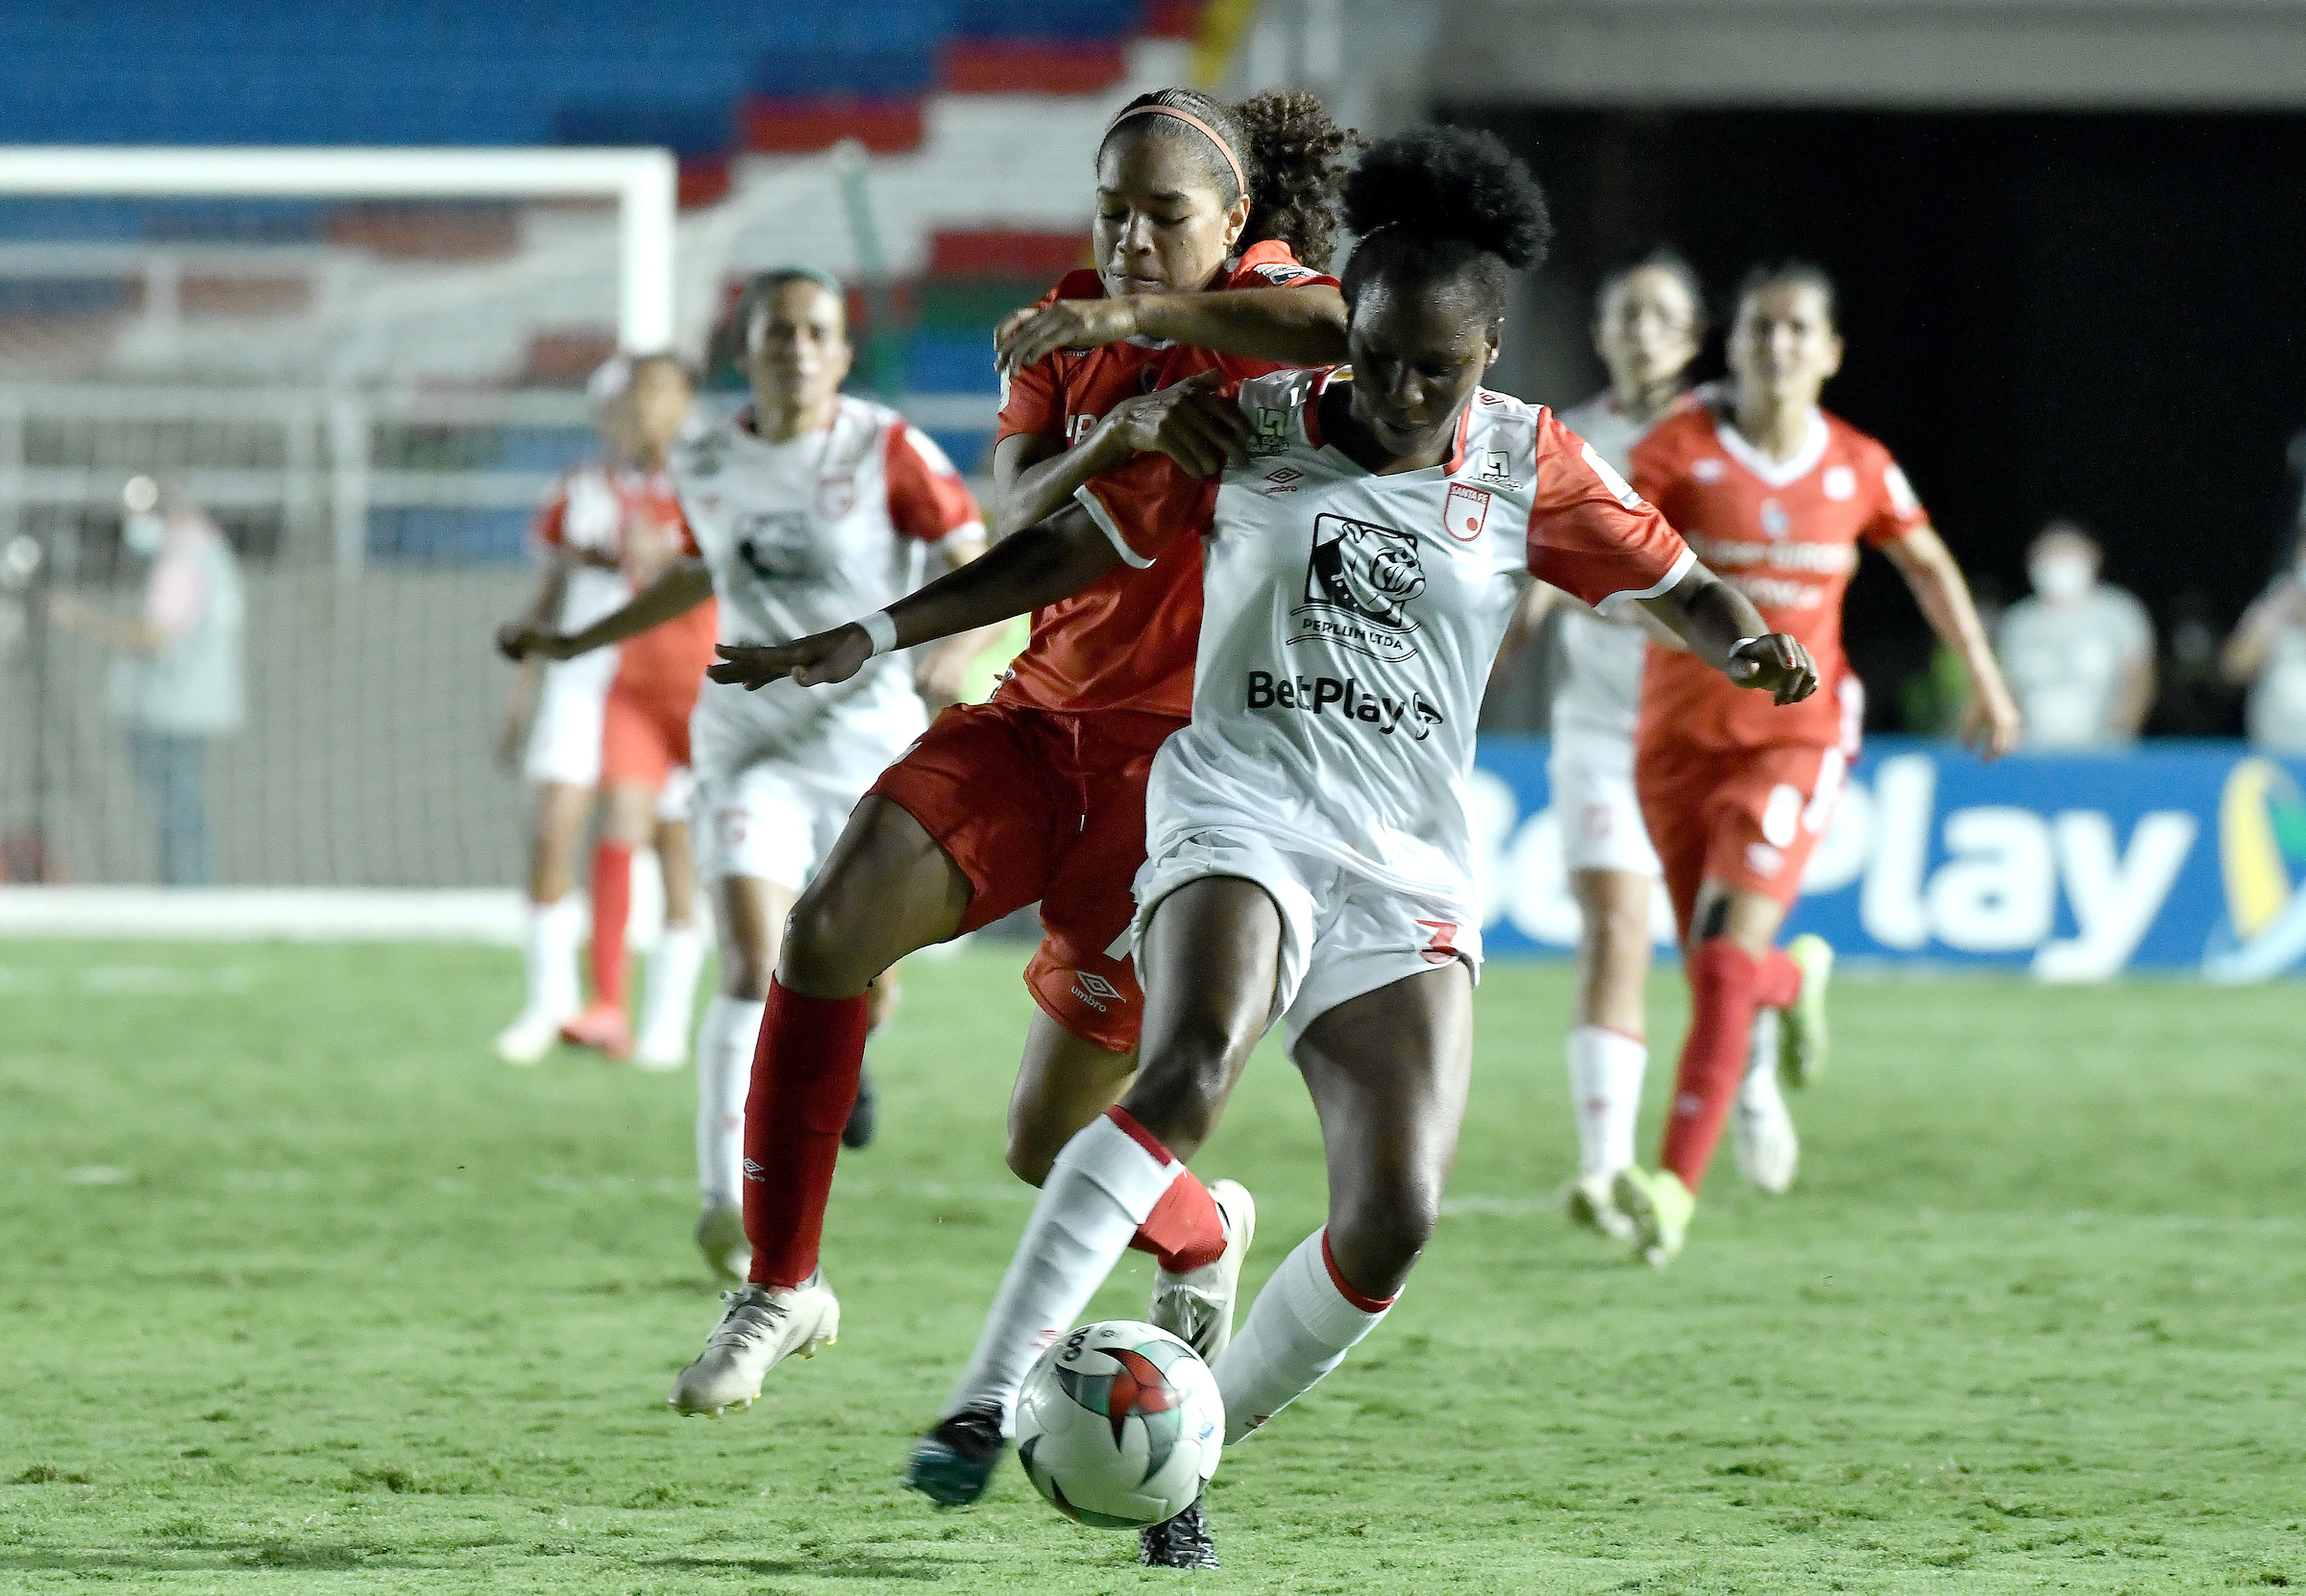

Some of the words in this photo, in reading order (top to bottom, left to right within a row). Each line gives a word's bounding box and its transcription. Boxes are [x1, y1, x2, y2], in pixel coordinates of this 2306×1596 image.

[1451, 485, 1478, 502] SANTA
[1369, 632, 1404, 651] LTDA
[1247, 671, 1405, 735] BetPlay
[1069, 985, 1108, 1013] umbro
